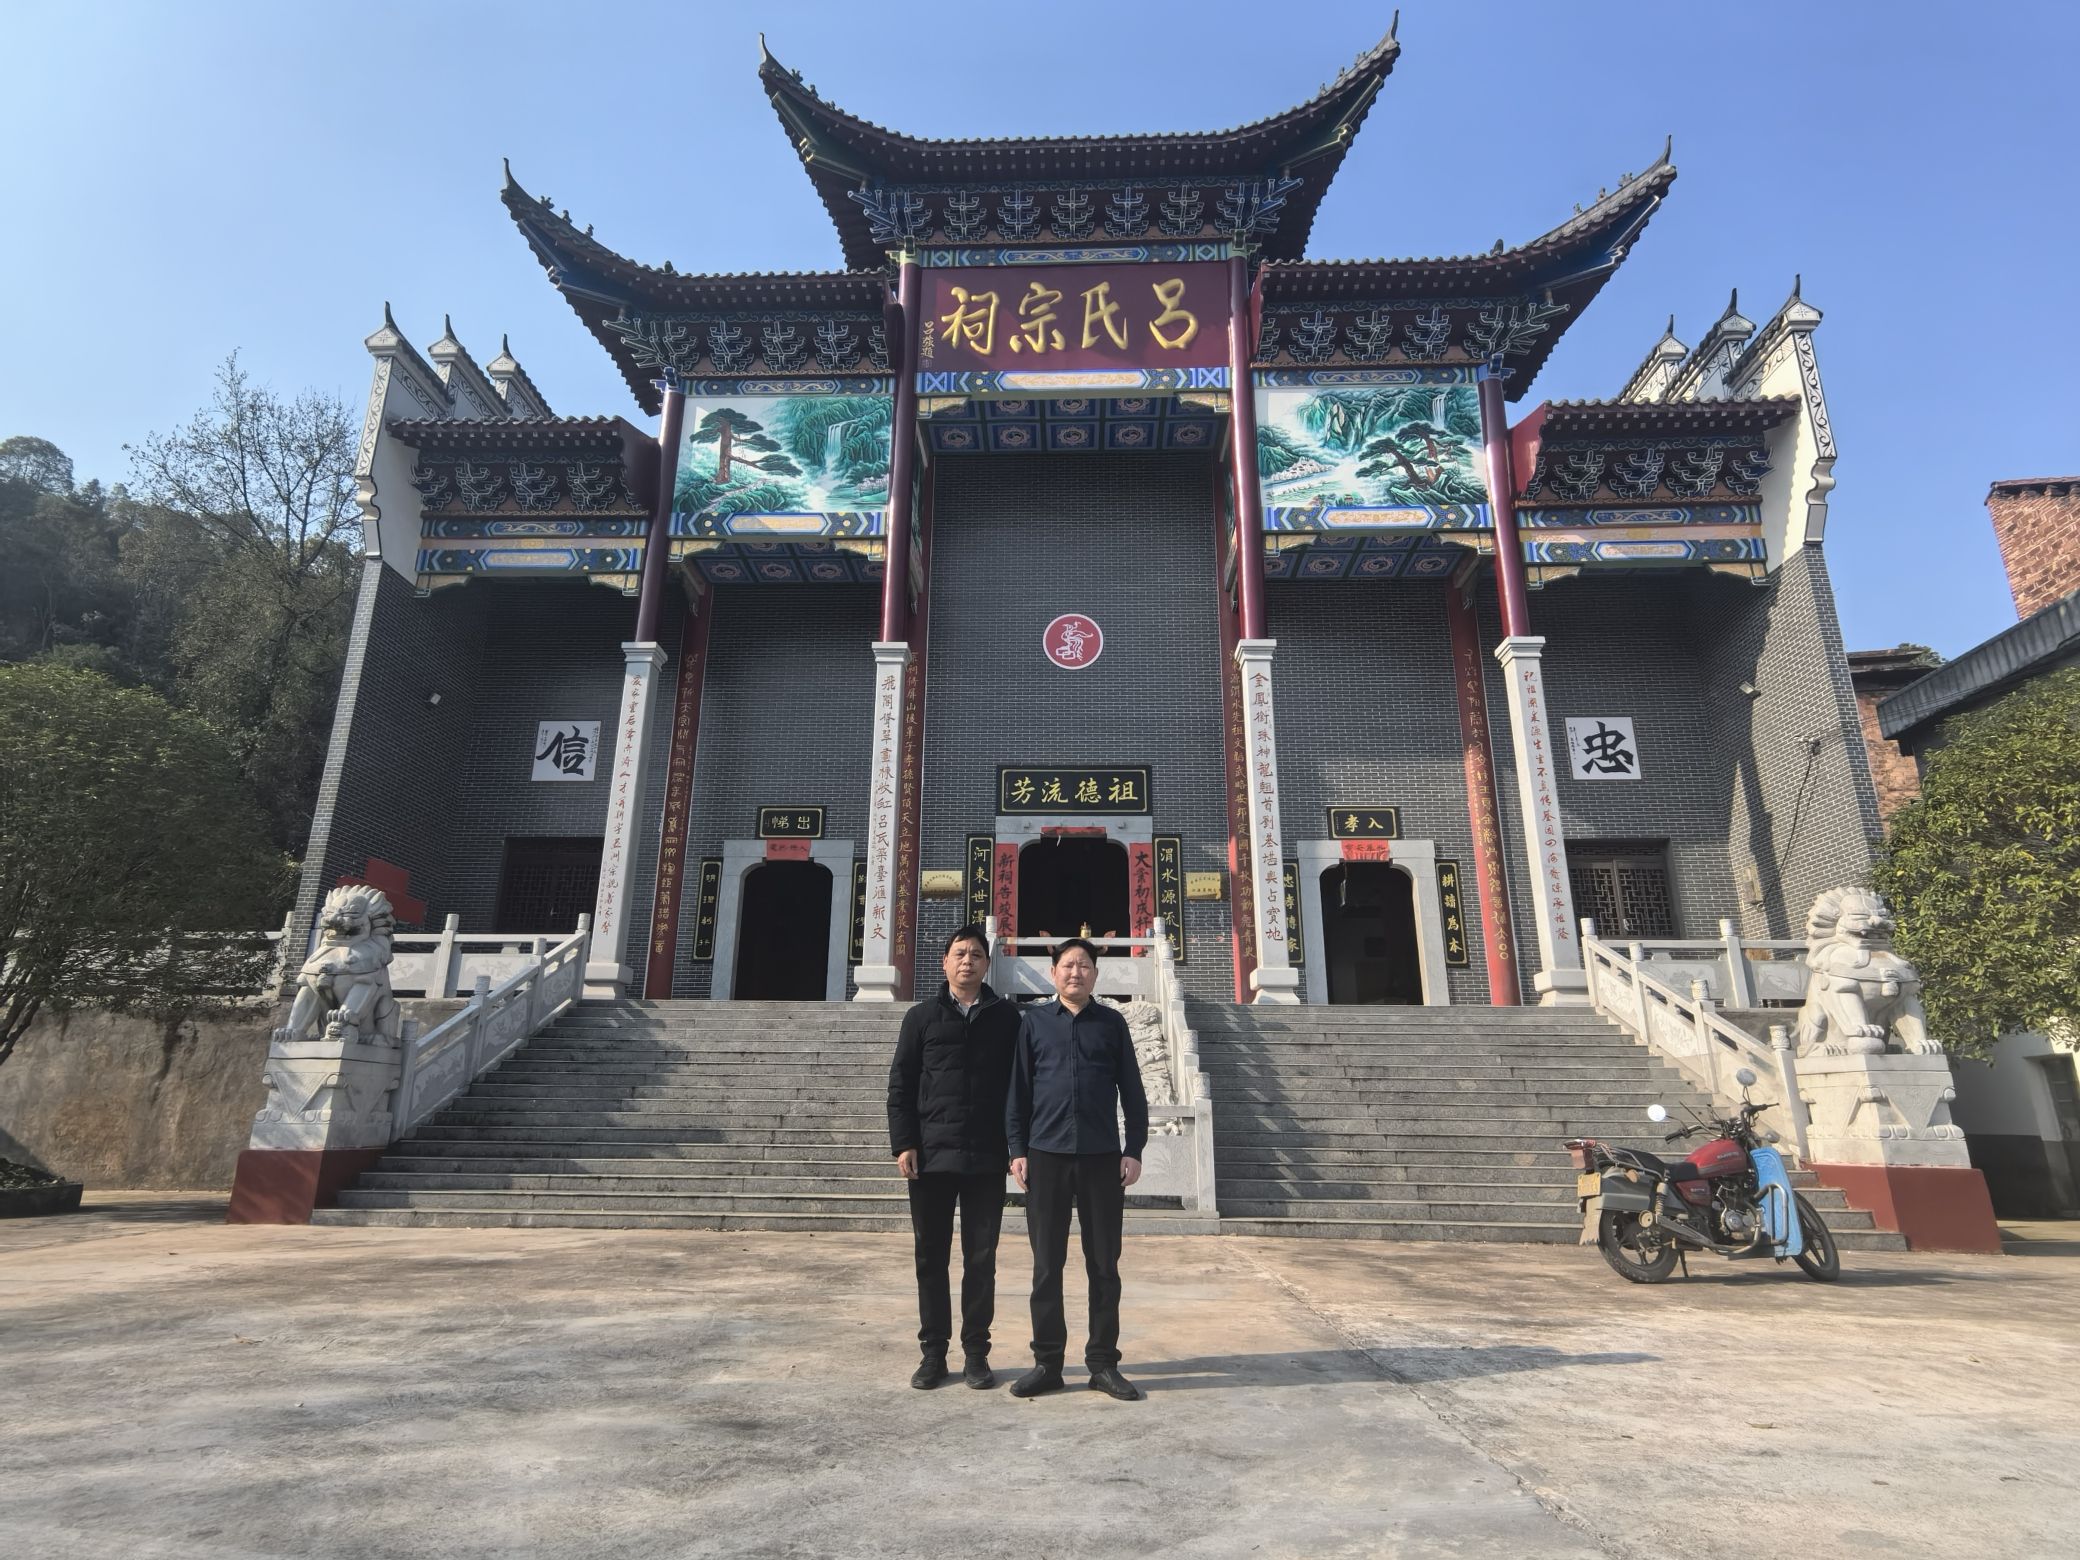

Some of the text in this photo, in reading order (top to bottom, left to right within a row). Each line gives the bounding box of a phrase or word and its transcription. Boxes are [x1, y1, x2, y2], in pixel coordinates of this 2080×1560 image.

[535, 725, 589, 776] 信
[1581, 720, 1634, 774] 忠
[1010, 777, 1138, 804] 祖德流芳
